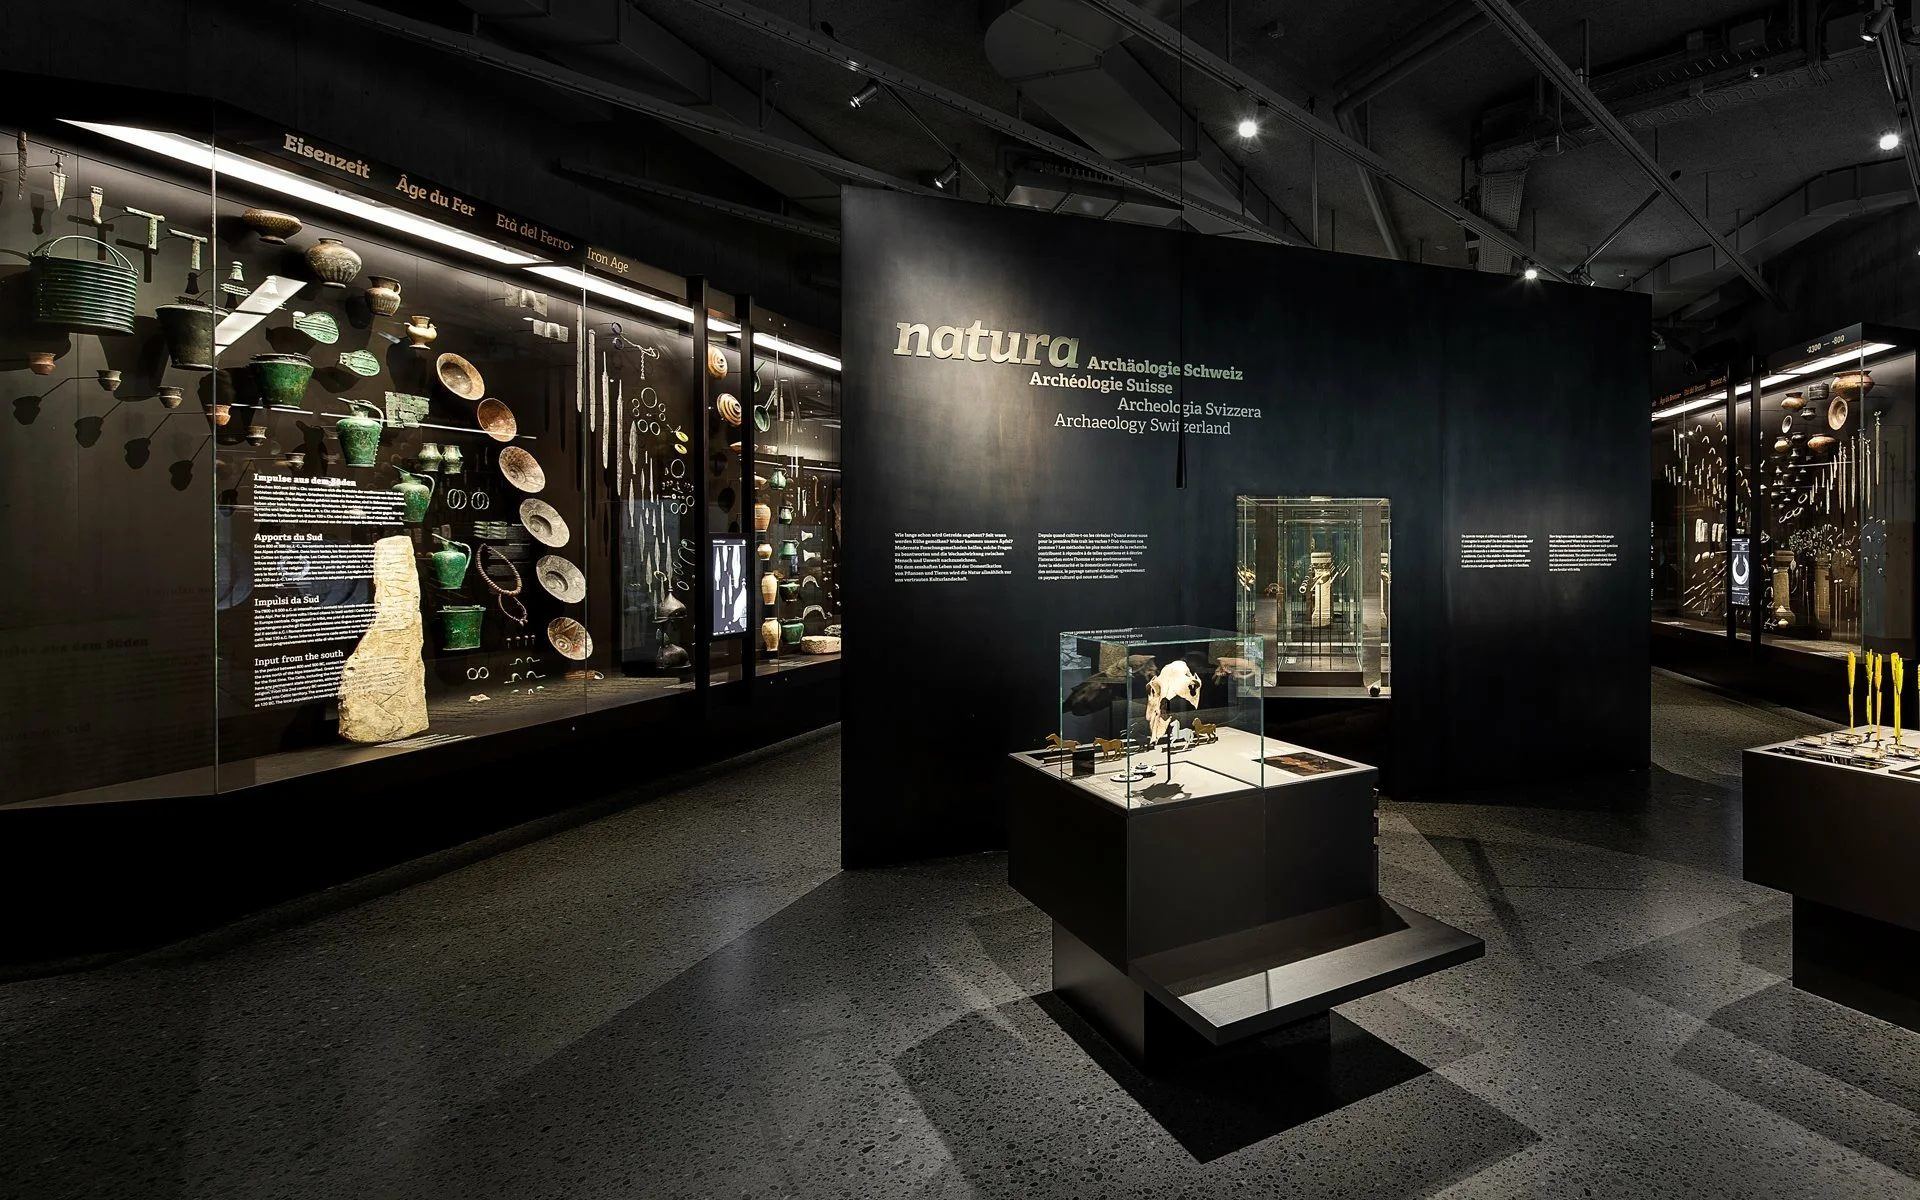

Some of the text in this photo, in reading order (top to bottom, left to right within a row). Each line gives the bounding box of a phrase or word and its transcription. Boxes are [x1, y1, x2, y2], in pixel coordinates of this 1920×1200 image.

[284, 134, 370, 180] Eisenzeit
[396, 174, 476, 217] Âge du Fer
[496, 213, 571, 251] Età del Ferro
[586, 246, 629, 273] Iron Age
[892, 320, 1080, 369] natura
[1086, 356, 1244, 381] Archäologie Schweiz
[1028, 372, 1173, 394] Archéologie Suisse
[1117, 397, 1262, 418] Archeologia Svizzera
[1054, 413, 1231, 435] Archaeology Switzerland
[254, 473, 292, 483] Impulse
[254, 533, 292, 543] Apports
[254, 597, 289, 607] Impulsi
[303, 595, 320, 604] Sud
[255, 657, 280, 667] Input
[282, 655, 303, 663] from
[320, 650, 344, 658] south
